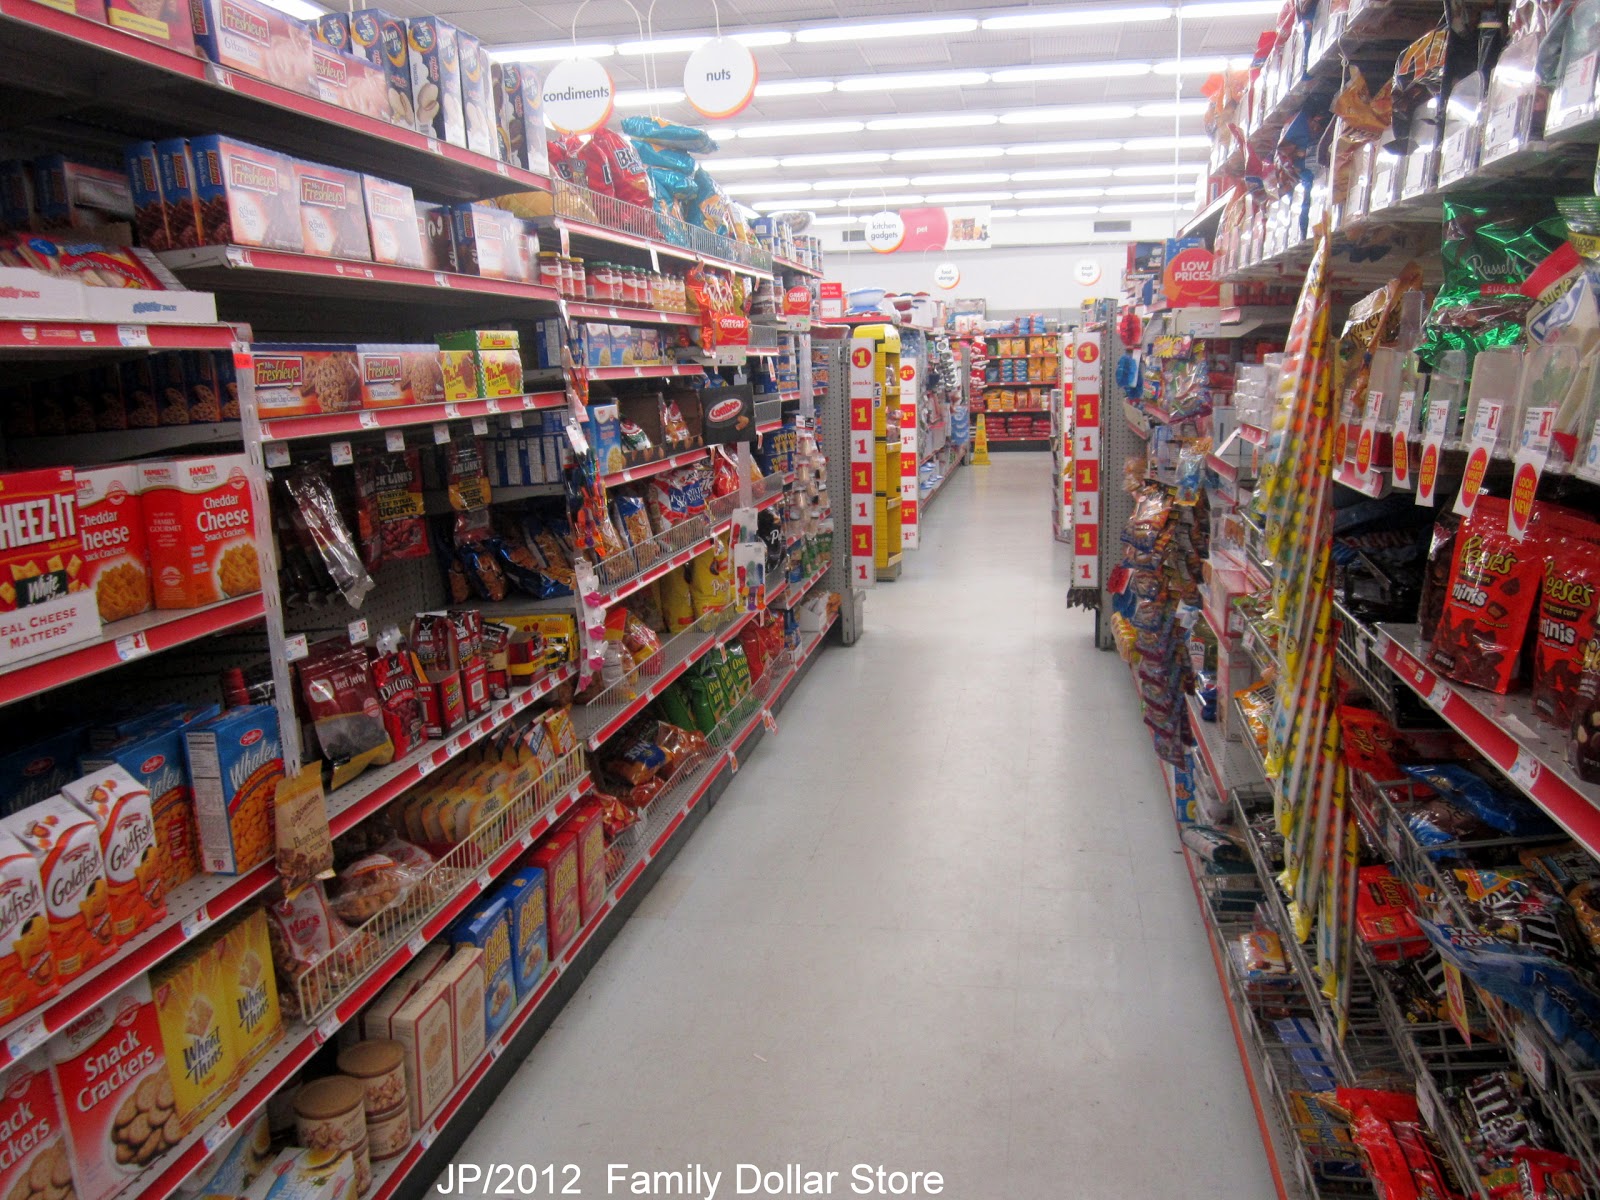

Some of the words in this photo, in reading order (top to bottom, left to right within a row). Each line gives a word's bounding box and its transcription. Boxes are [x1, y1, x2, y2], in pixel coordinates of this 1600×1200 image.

[706, 68, 731, 81] nuts
[543, 85, 610, 103] condiments
[870, 232, 899, 241] gadgets
[872, 222, 897, 230] kitchen
[916, 225, 928, 235] pet
[1175, 271, 1213, 281] PRICES
[1181, 261, 1210, 272] LOW
[1465, 254, 1520, 281] Russell
[256, 361, 300, 391] Freshley's
[367, 360, 399, 384] Freshley's
[1078, 374, 1097, 382] candy
[711, 401, 740, 418] Combos
[1472, 460, 1483, 471] LOOK
[1519, 477, 1534, 490] LOOK
[203, 495, 239, 510] Cheddar
[197, 508, 249, 533] Cheese
[82, 525, 130, 551] heese
[204, 532, 222, 542] Snack
[223, 527, 246, 539] Crackers
[1459, 534, 1518, 575] Reese's
[28, 574, 60, 604] White
[1451, 582, 1488, 608] minis
[29, 607, 78, 628] CHEESE
[1563, 609, 1577, 618] CUPS
[335, 679, 349, 691] Beef
[349, 673, 367, 687] Jerky
[230, 738, 278, 791] Whales
[150, 765, 182, 801] ales
[110, 816, 153, 872] Goldfish
[52, 848, 101, 908] Goldfish
[236, 980, 268, 1016] Wheat
[238, 1000, 270, 1035] Thins
[84, 1029, 142, 1082] Snack
[183, 1025, 221, 1064] Wheat
[185, 1044, 223, 1085] Thins
[76, 1044, 156, 1113] Crackers
